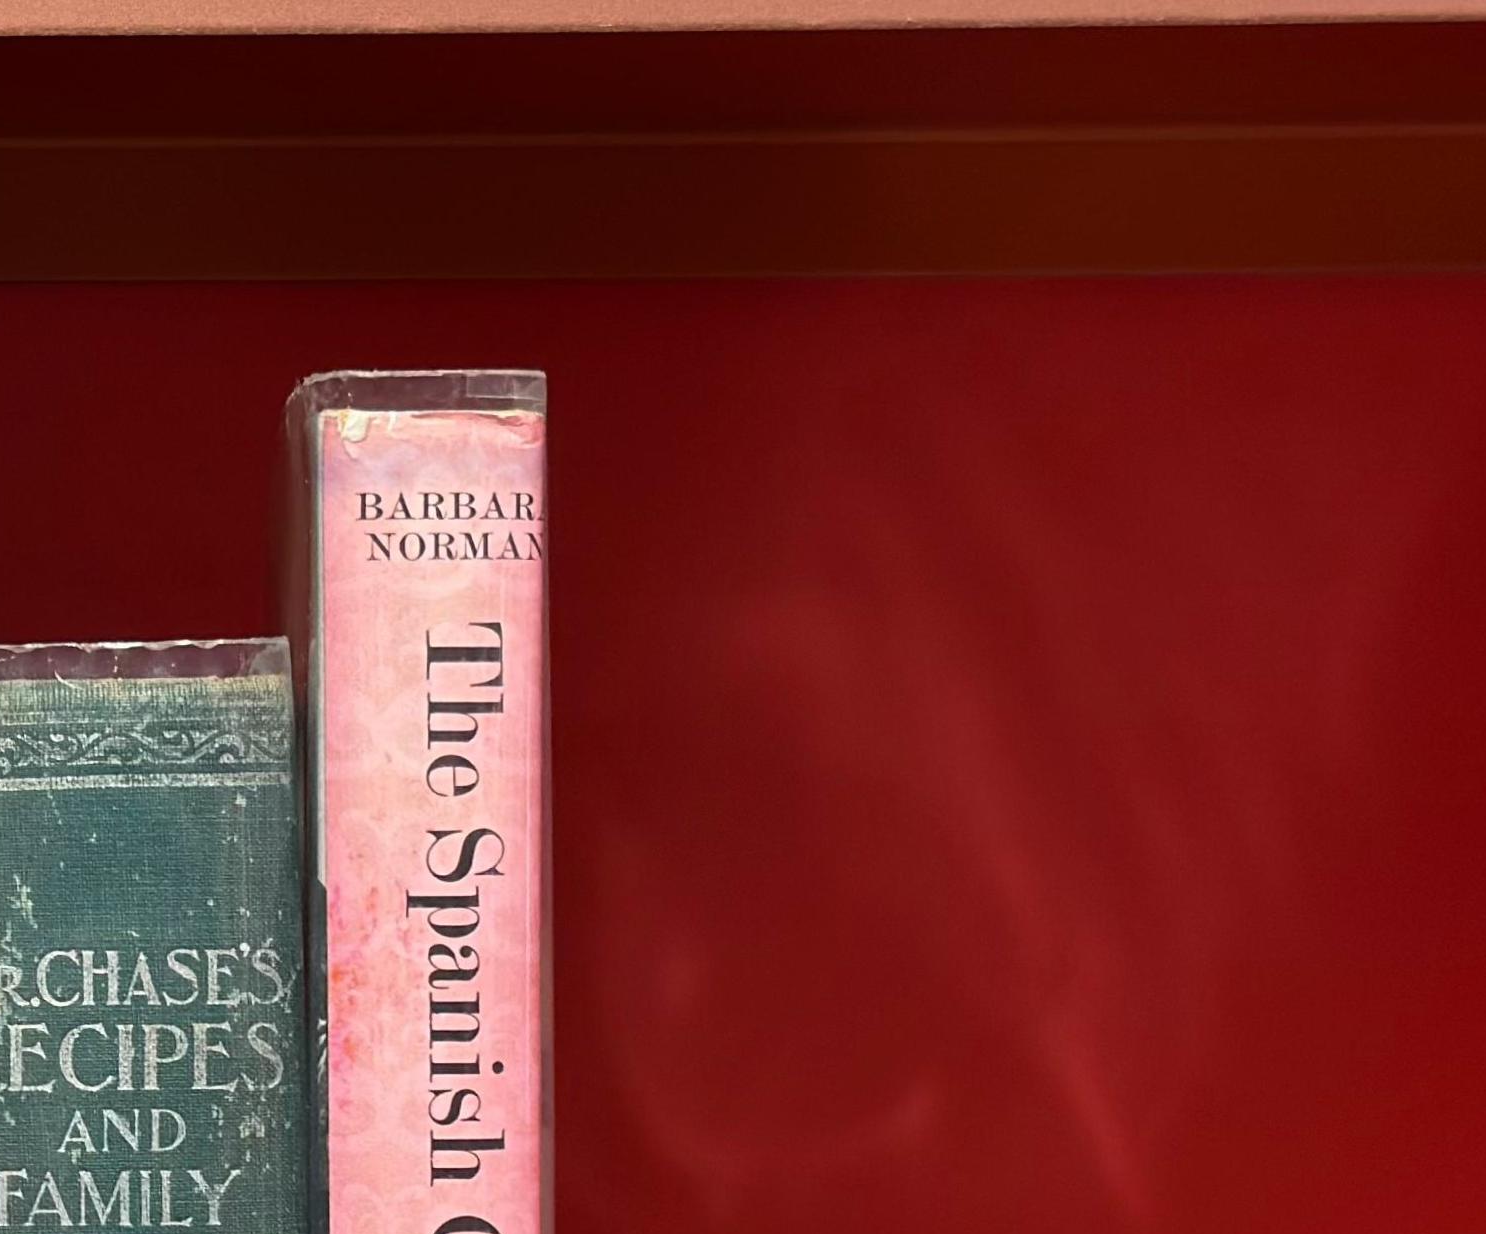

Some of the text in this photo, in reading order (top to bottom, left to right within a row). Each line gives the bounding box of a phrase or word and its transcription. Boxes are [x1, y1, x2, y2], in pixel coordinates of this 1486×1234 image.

[424, 620, 506, 799] The
[405, 828, 506, 1188] Spanish
[57, 1109, 187, 1155] AND
